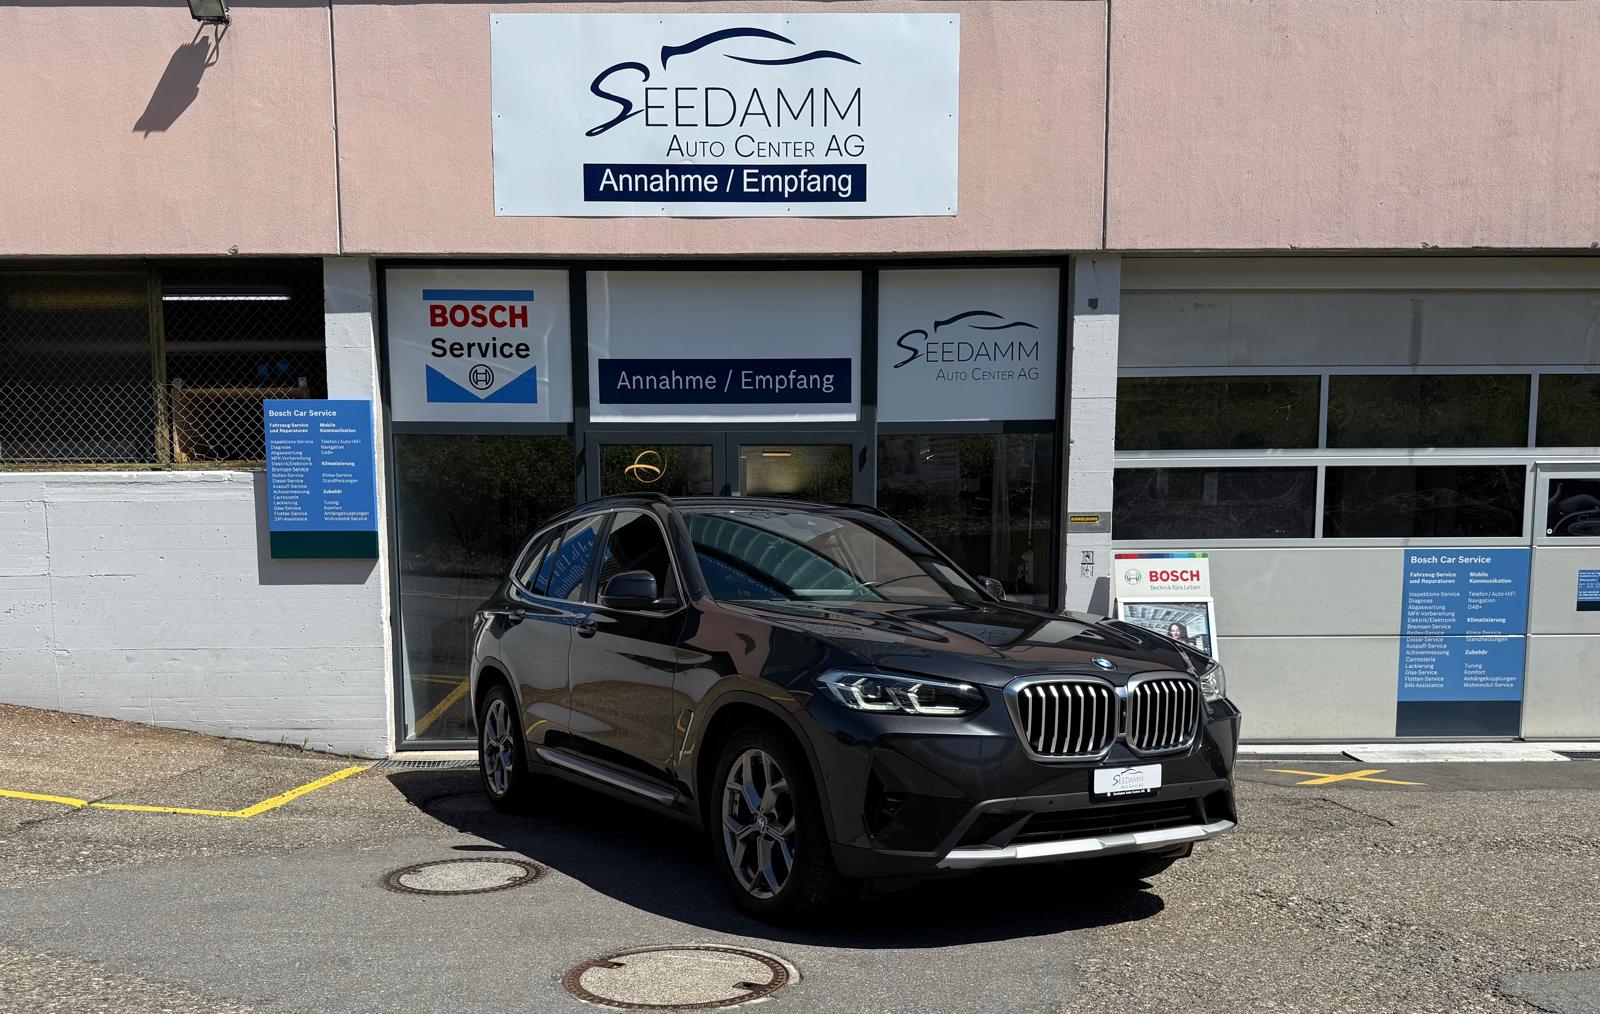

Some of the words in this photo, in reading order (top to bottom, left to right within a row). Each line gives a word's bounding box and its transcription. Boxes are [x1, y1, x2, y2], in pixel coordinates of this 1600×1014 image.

[585, 61, 861, 137] SEEDAMM
[825, 134, 865, 158] AG
[599, 168, 718, 193] Annahme
[726, 168, 734, 193] /
[743, 169, 852, 198] Empfang
[429, 304, 528, 328] BOSCH
[430, 337, 531, 359] Service
[893, 329, 1039, 369] SEEDAMM
[616, 370, 717, 390] Annahme
[724, 369, 732, 393] /
[741, 370, 834, 393] Empfang
[1018, 367, 1039, 381] AG
[1459, 556, 1491, 564] Service
[1149, 570, 1200, 582] BOSCH
